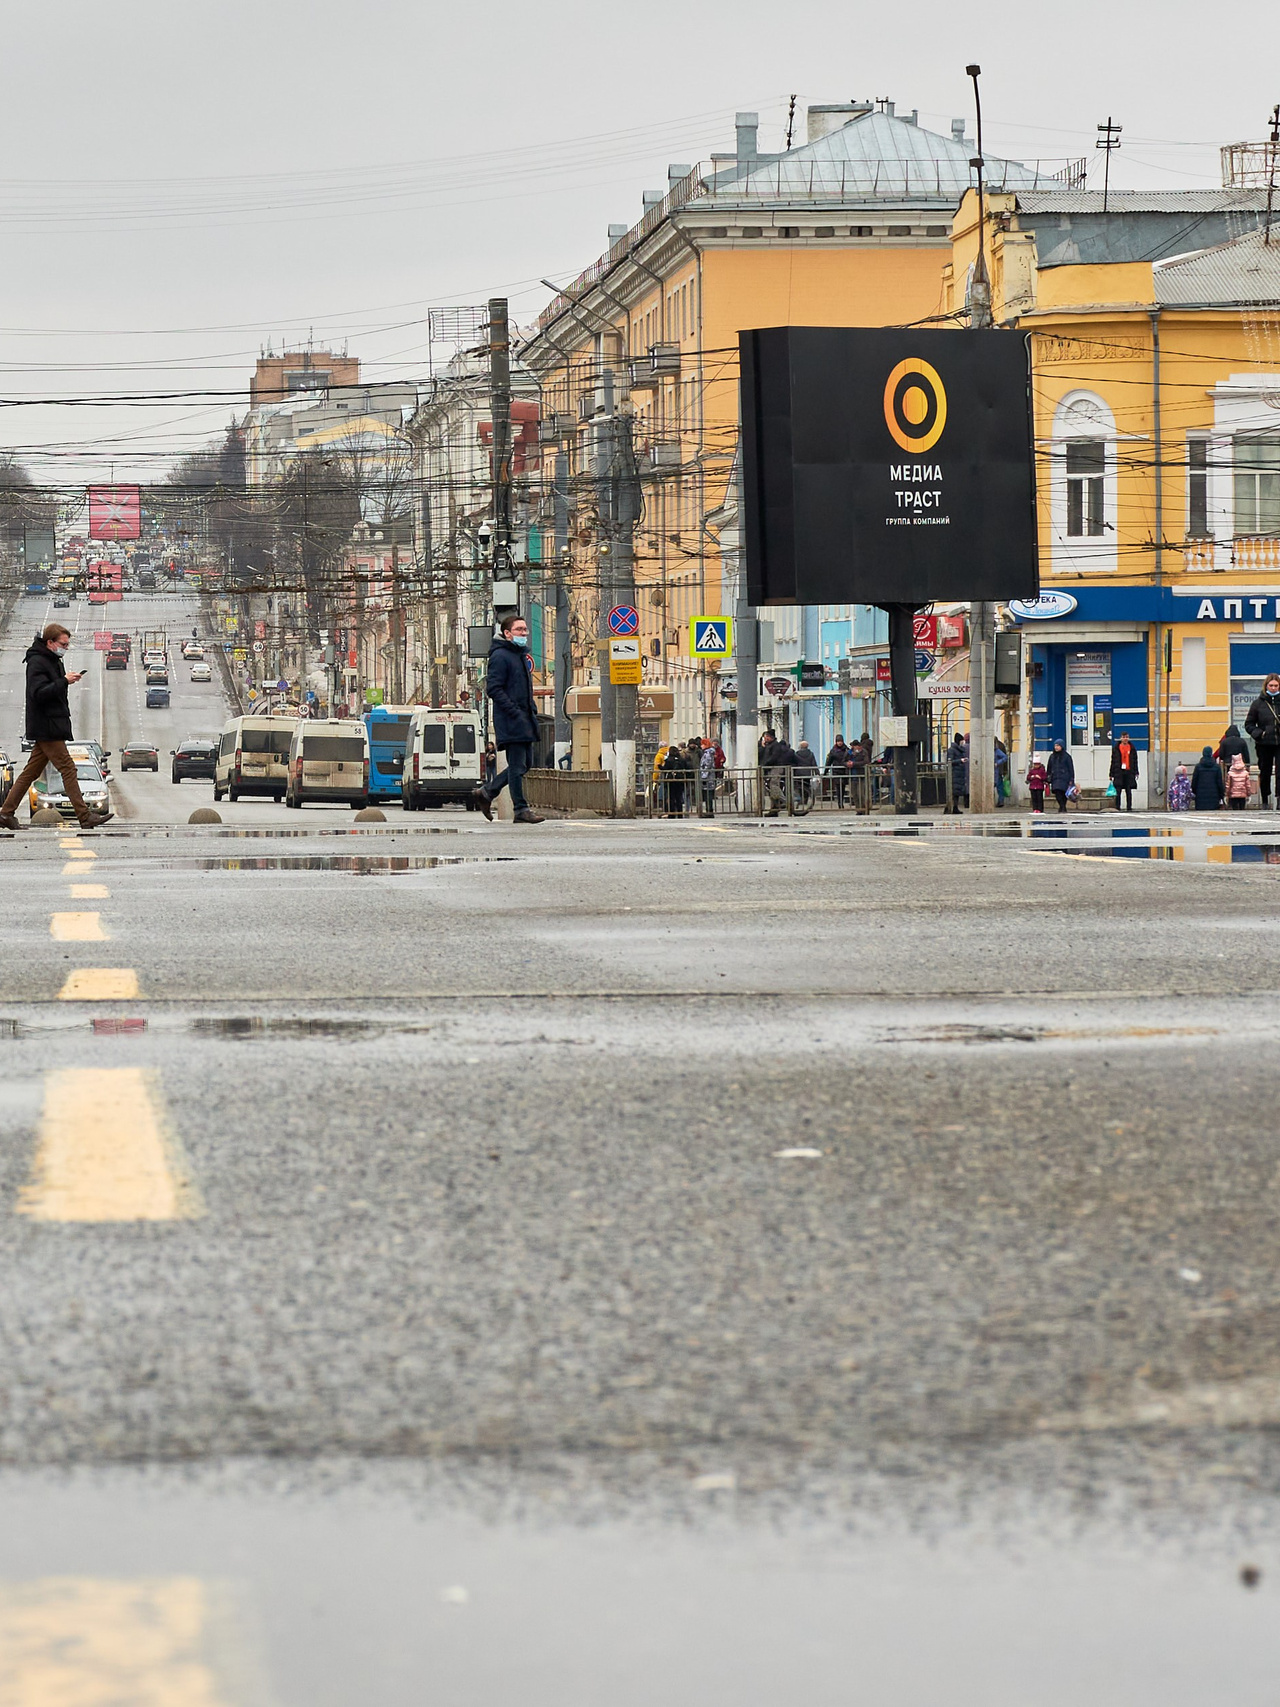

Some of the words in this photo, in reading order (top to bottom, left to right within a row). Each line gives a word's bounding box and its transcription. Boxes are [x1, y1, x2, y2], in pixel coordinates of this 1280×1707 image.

[890, 465, 943, 482] МЕДИА
[895, 491, 941, 507] ТРАСТ
[913, 516, 950, 525] КОМПАНИЙ
